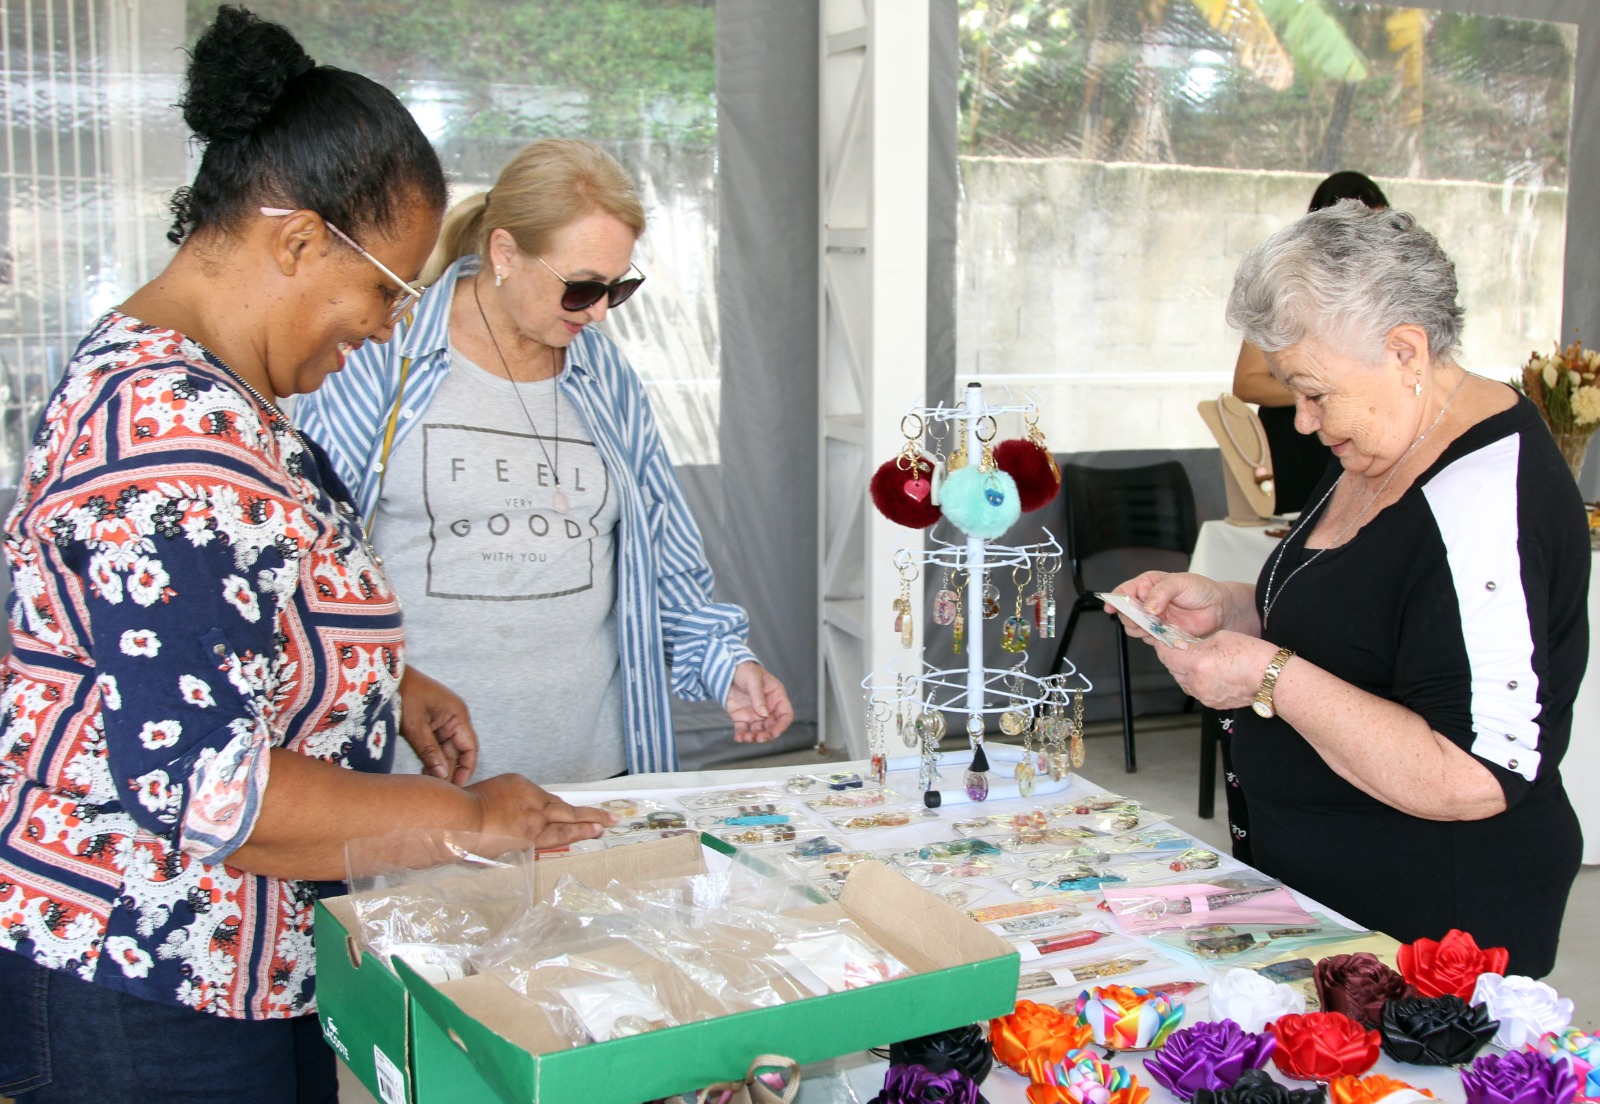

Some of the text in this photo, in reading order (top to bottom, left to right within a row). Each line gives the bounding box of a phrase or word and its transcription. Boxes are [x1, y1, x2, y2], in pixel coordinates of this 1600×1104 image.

[451, 458, 586, 492] FEEL
[504, 498, 533, 508] VERY
[450, 513, 582, 539] GOOD
[481, 552, 547, 562] WITH YOU
